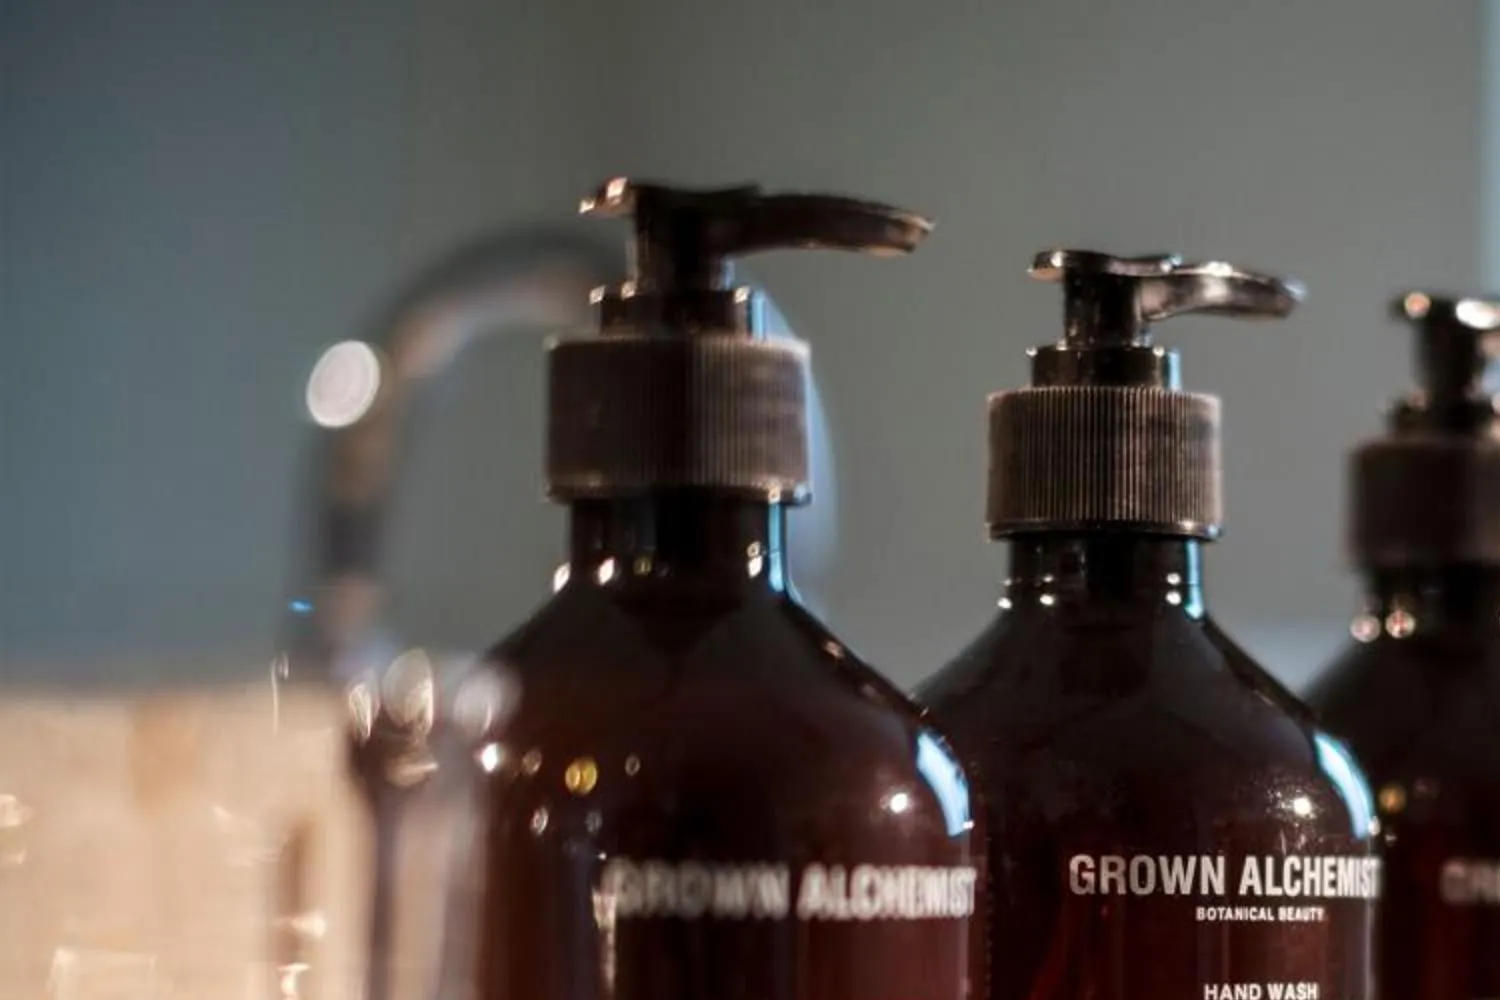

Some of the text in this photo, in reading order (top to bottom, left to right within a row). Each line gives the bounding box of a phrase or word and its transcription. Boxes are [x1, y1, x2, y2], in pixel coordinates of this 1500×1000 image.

[1069, 855, 1380, 897] GROWN ALCHEMIST
[1196, 908, 1325, 921] BOTANICAL BEAUTY
[1204, 983, 1319, 1000] HAND WASH
